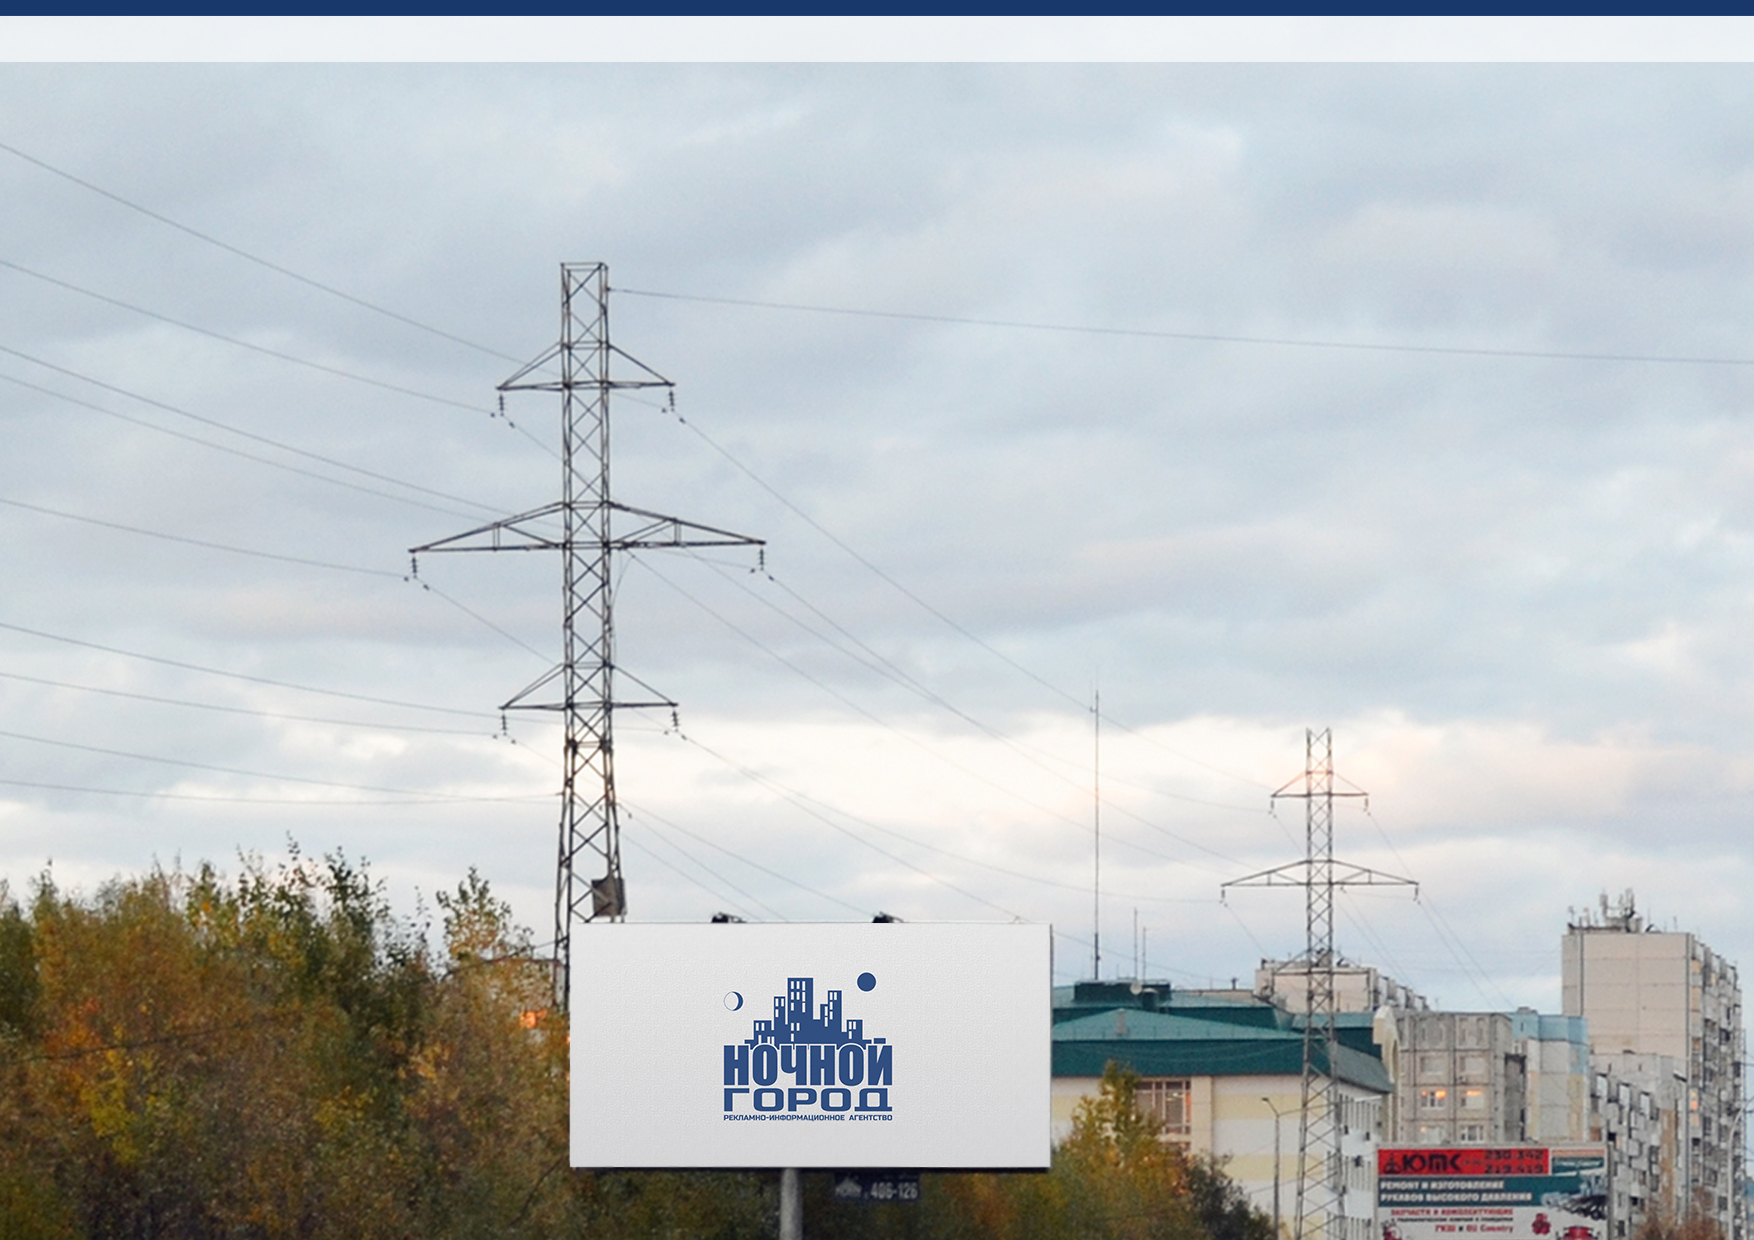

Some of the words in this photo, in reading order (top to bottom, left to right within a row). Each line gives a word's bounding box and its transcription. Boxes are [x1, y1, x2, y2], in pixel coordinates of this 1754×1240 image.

[724, 1038, 892, 1086] НОЧНОЙ
[724, 1088, 892, 1112] ГОРОД
[870, 1182, 918, 1199] 406-126
[1380, 1181, 1419, 1190] РЕМОНТ
[1421, 1181, 1429, 1189] И
[1430, 1180, 1504, 1190] ИЗГОТОВЛЕНИЕ
[1380, 1193, 1424, 1202] РУКАВОВ
[1425, 1193, 1480, 1201] ВЫСОКОГО
[1481, 1193, 1532, 1201] ДАВЛЕНИЯ
